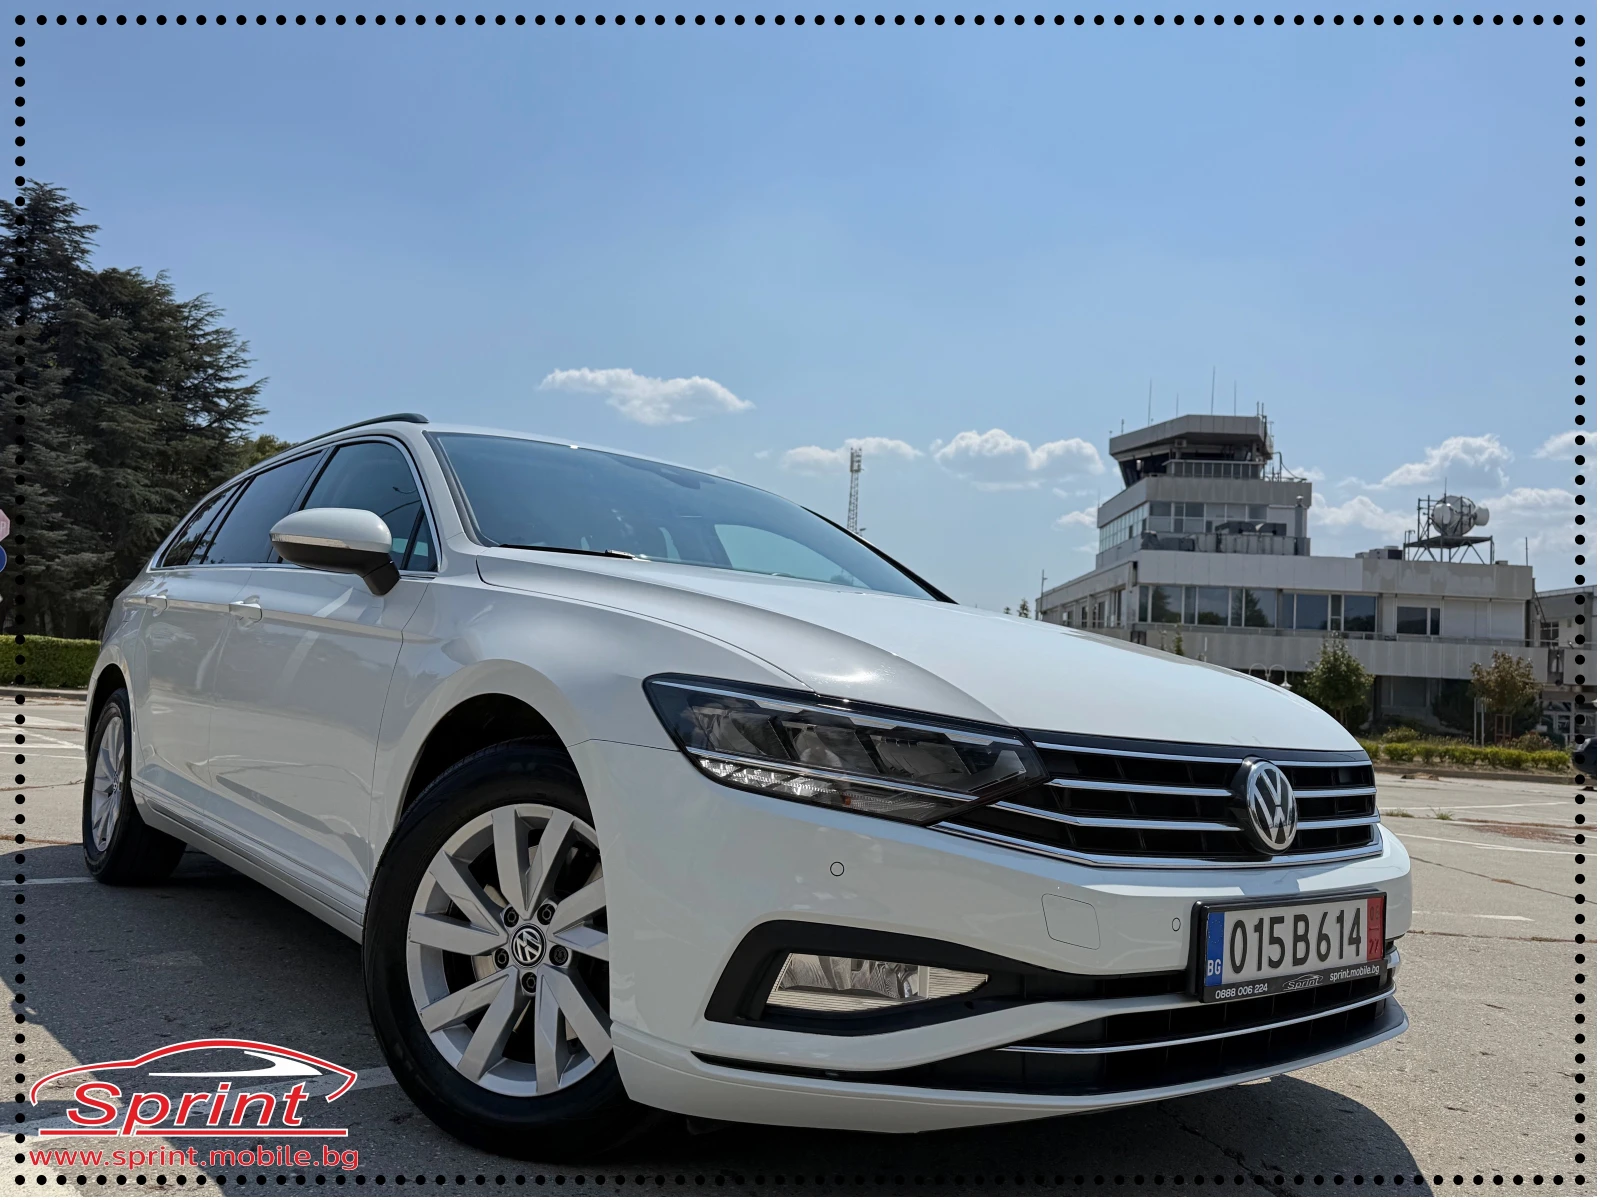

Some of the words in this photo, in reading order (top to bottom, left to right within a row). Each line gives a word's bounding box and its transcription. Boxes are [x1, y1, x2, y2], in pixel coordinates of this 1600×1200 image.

[1229, 907, 1362, 974] 015B614
[1207, 958, 1222, 976] BG
[1329, 964, 1380, 982] sprint.mobile.bg
[1215, 988, 1236, 1000] 0888
[1237, 985, 1253, 996] 006
[1254, 982, 1268, 994] 224
[1286, 976, 1320, 990] Sprint
